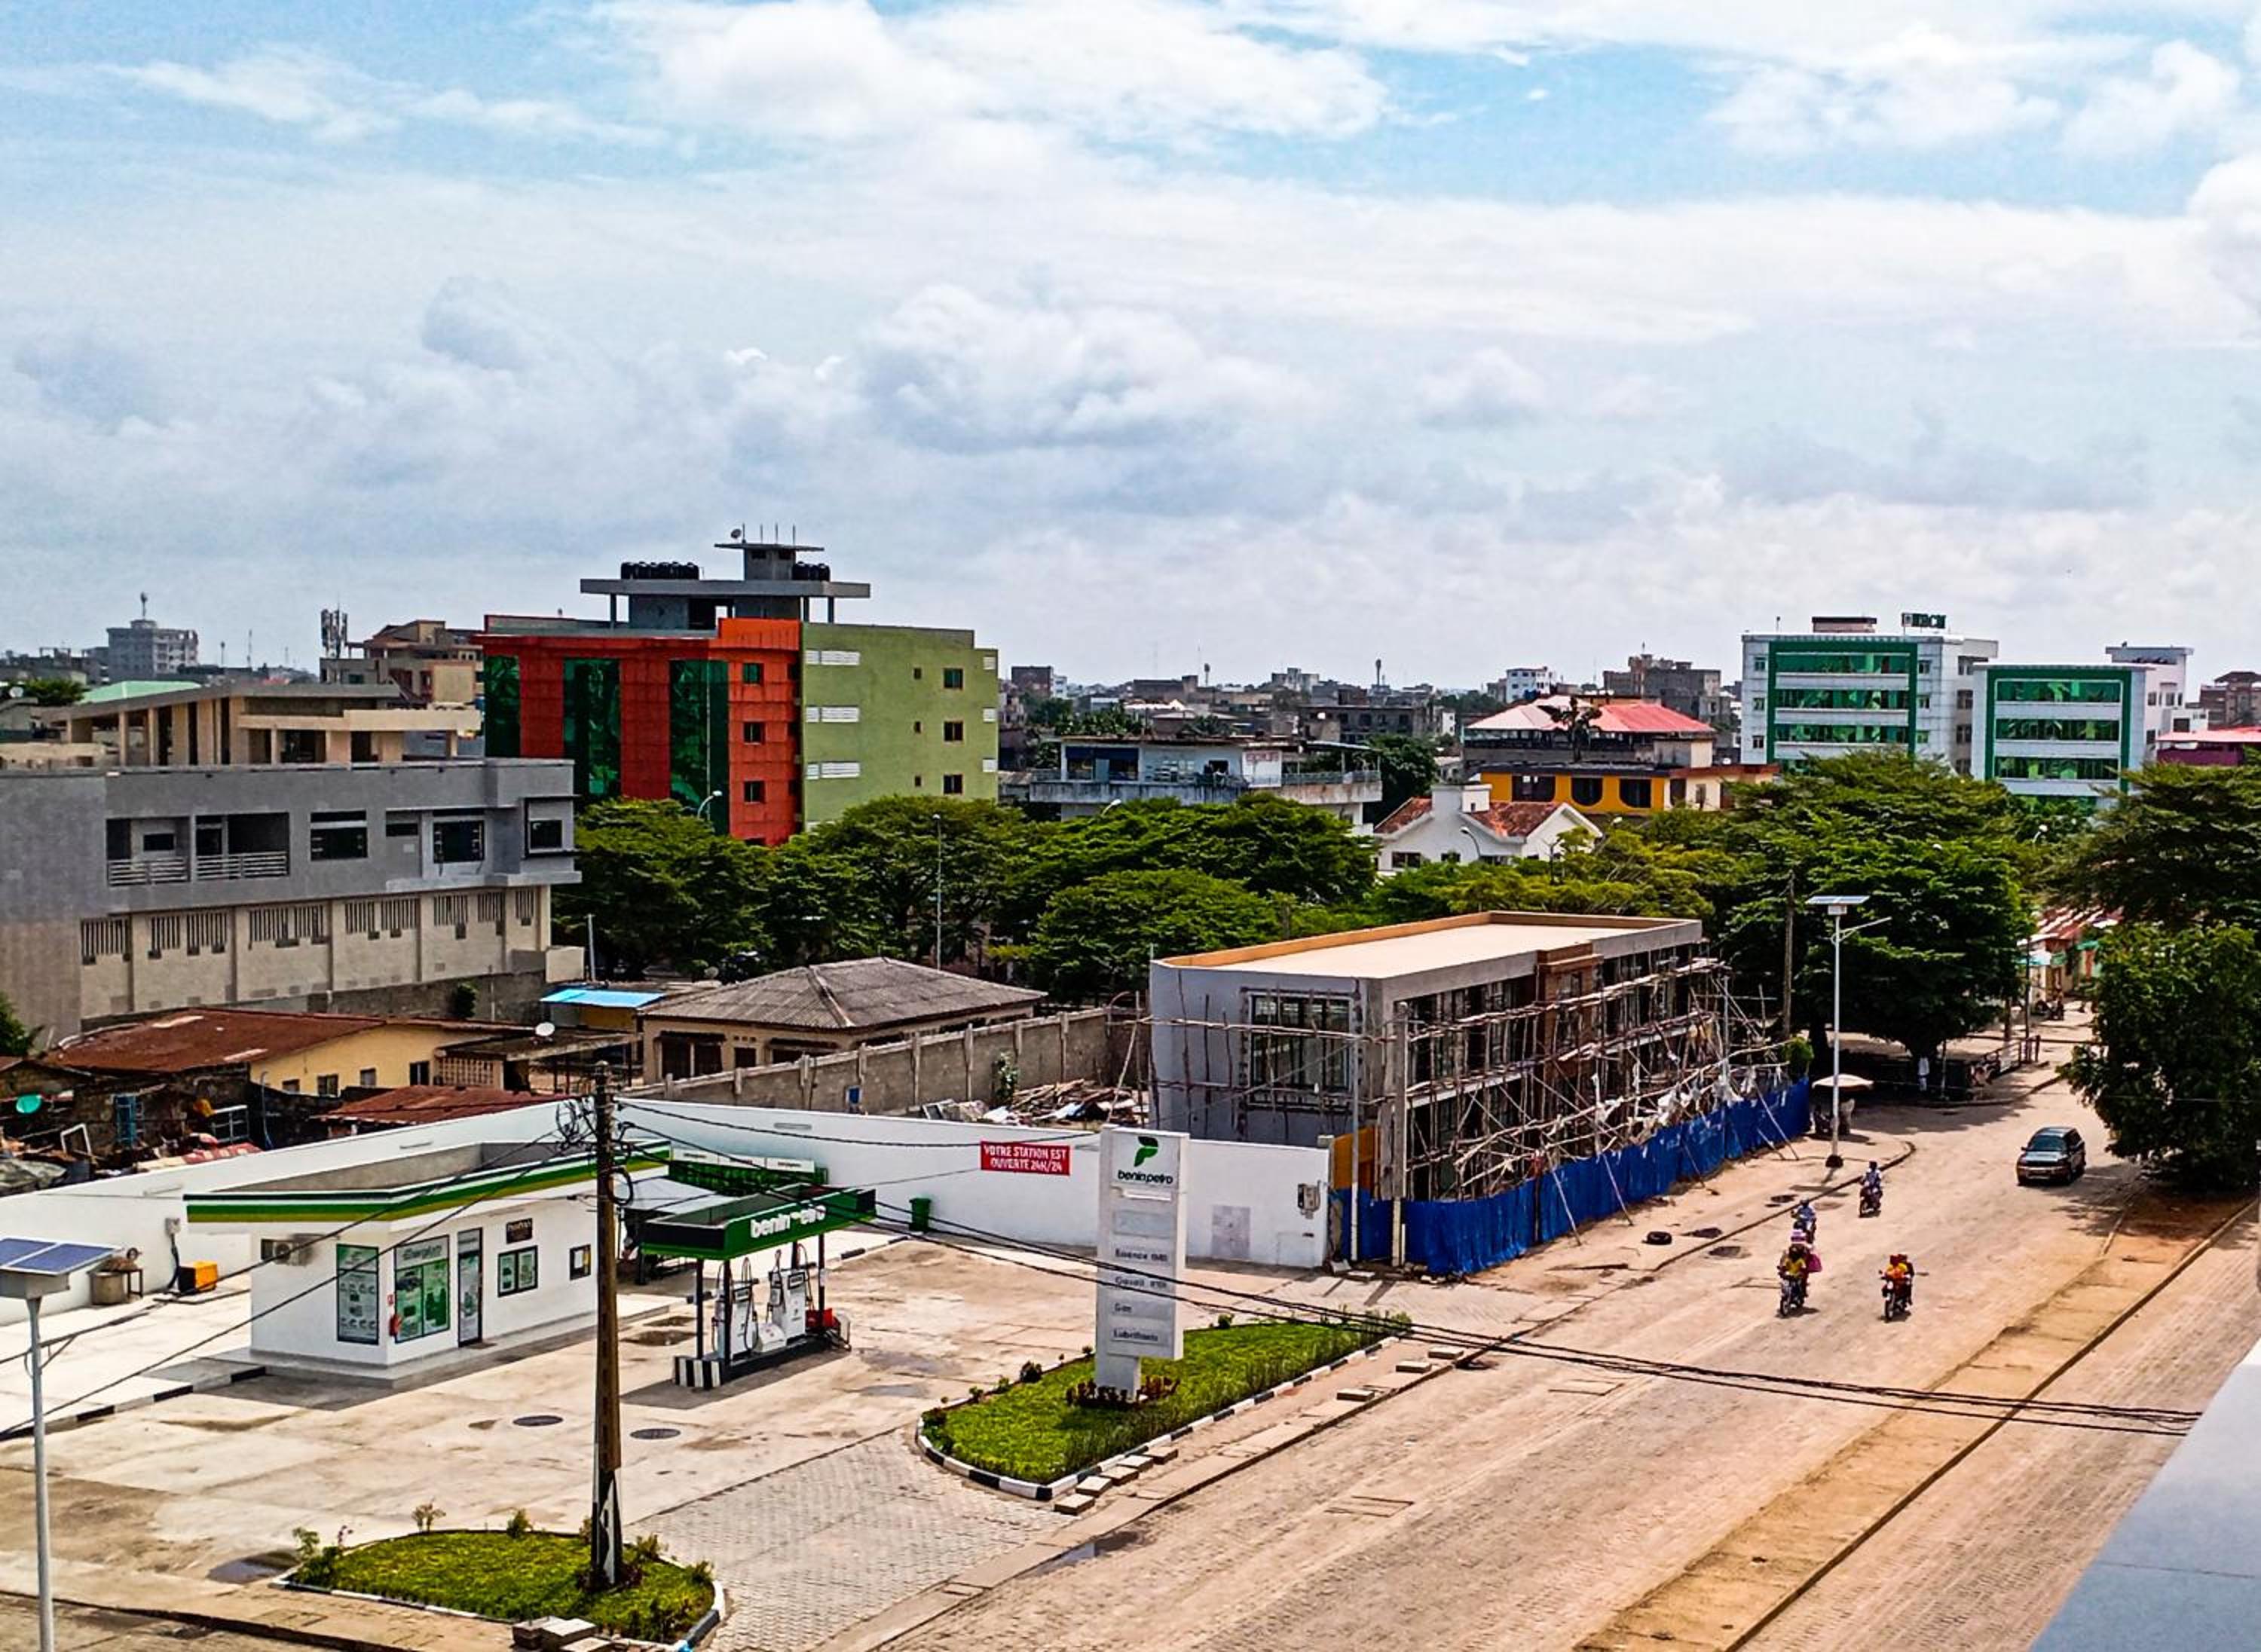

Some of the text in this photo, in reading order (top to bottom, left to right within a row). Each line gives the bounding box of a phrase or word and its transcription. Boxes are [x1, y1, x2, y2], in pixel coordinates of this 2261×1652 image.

[984, 1144, 1067, 1161] VOTRE STATION EST
[990, 1158, 1030, 1170] OUVERTE
